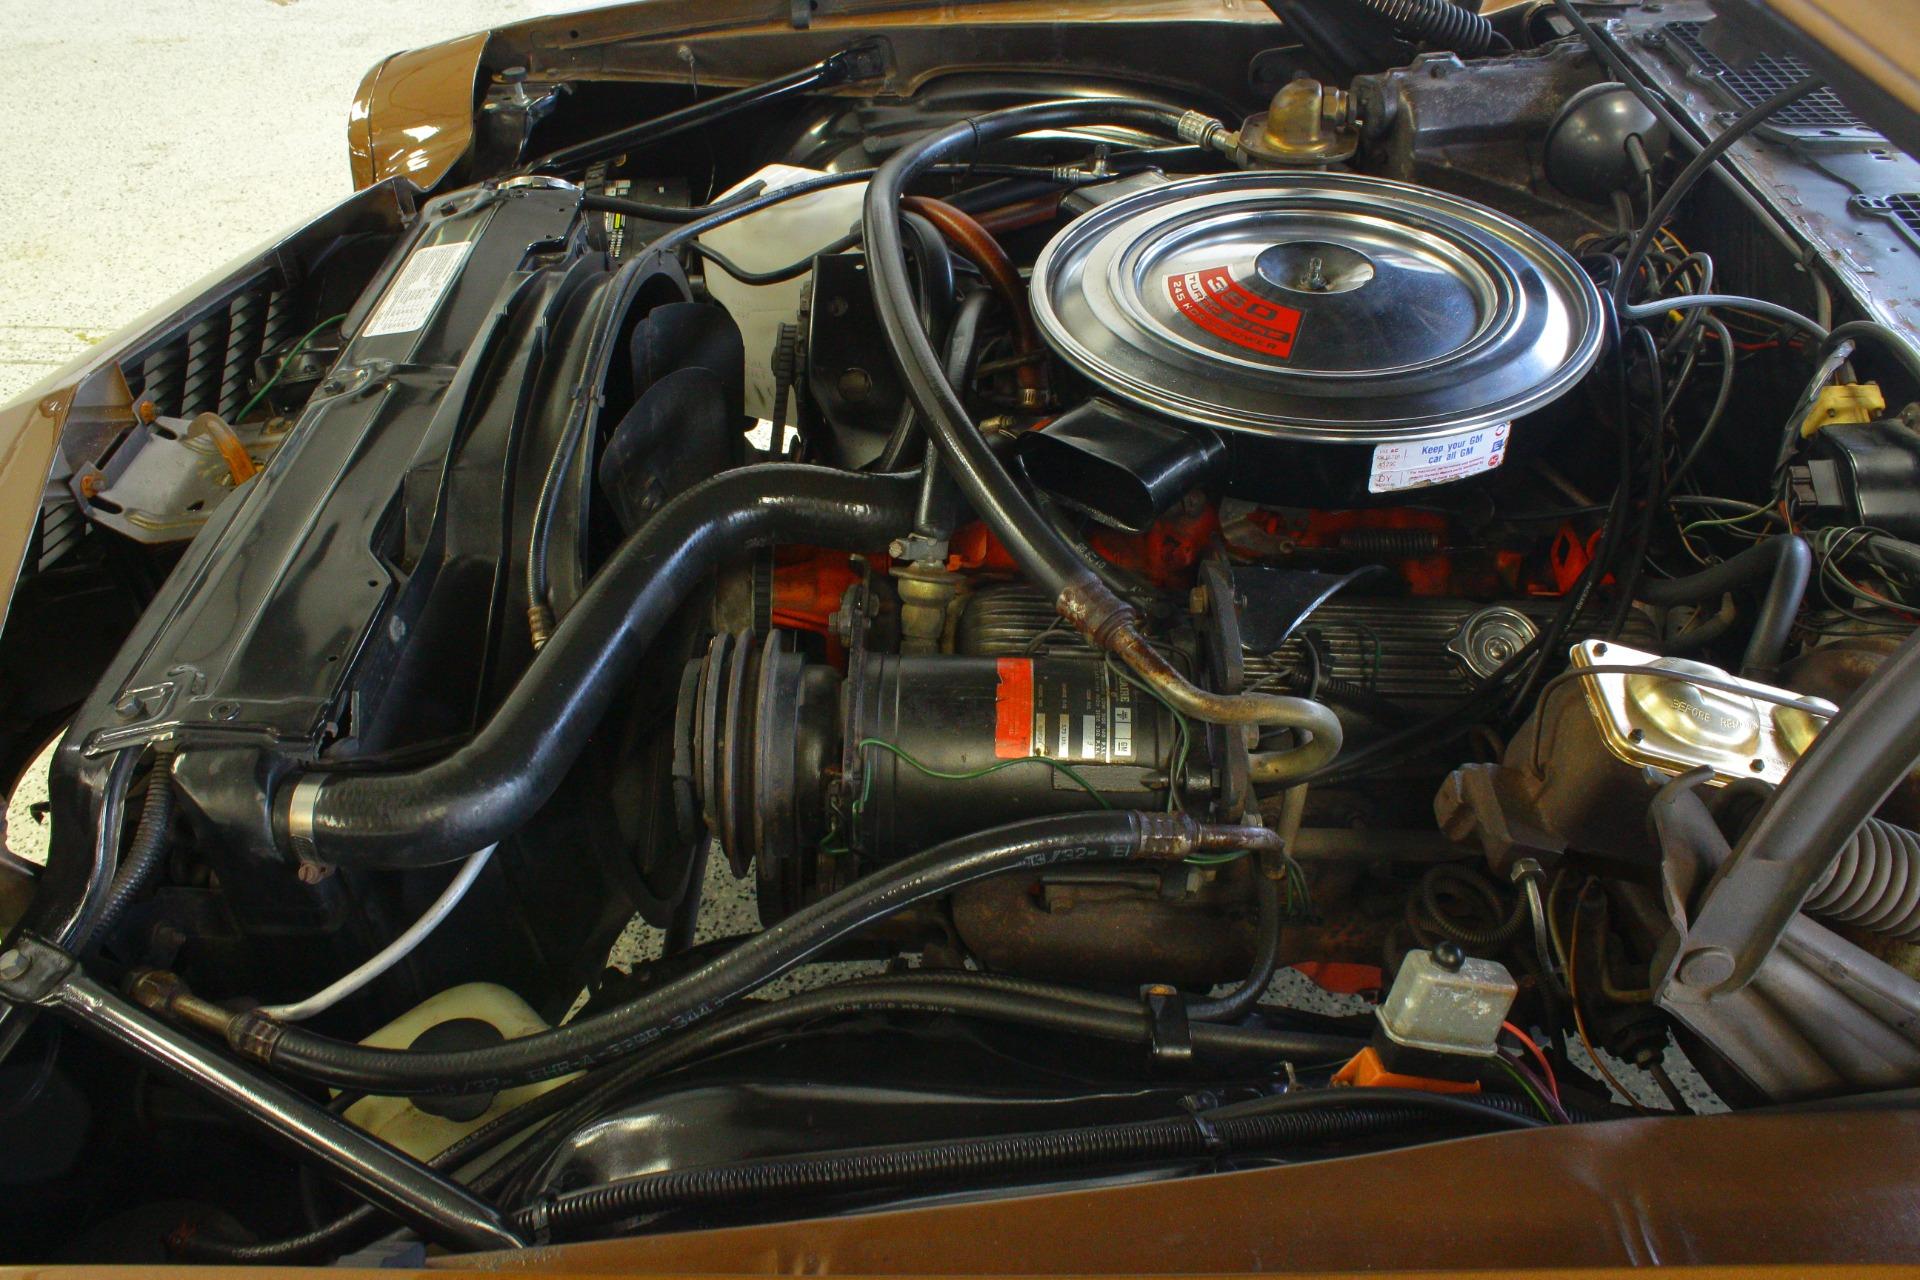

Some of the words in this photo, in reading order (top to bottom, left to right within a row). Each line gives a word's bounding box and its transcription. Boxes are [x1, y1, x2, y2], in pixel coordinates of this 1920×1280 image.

[1173, 281, 1186, 301] 245
[1207, 276, 1278, 320] 350
[1421, 445, 1444, 455] Keep
[1447, 441, 1466, 452] your
[1469, 434, 1483, 445] GM
[1428, 455, 1443, 464] car
[1446, 452, 1457, 461] all
[1460, 447, 1474, 457] GM
[1672, 697, 1712, 721] BEFORE
